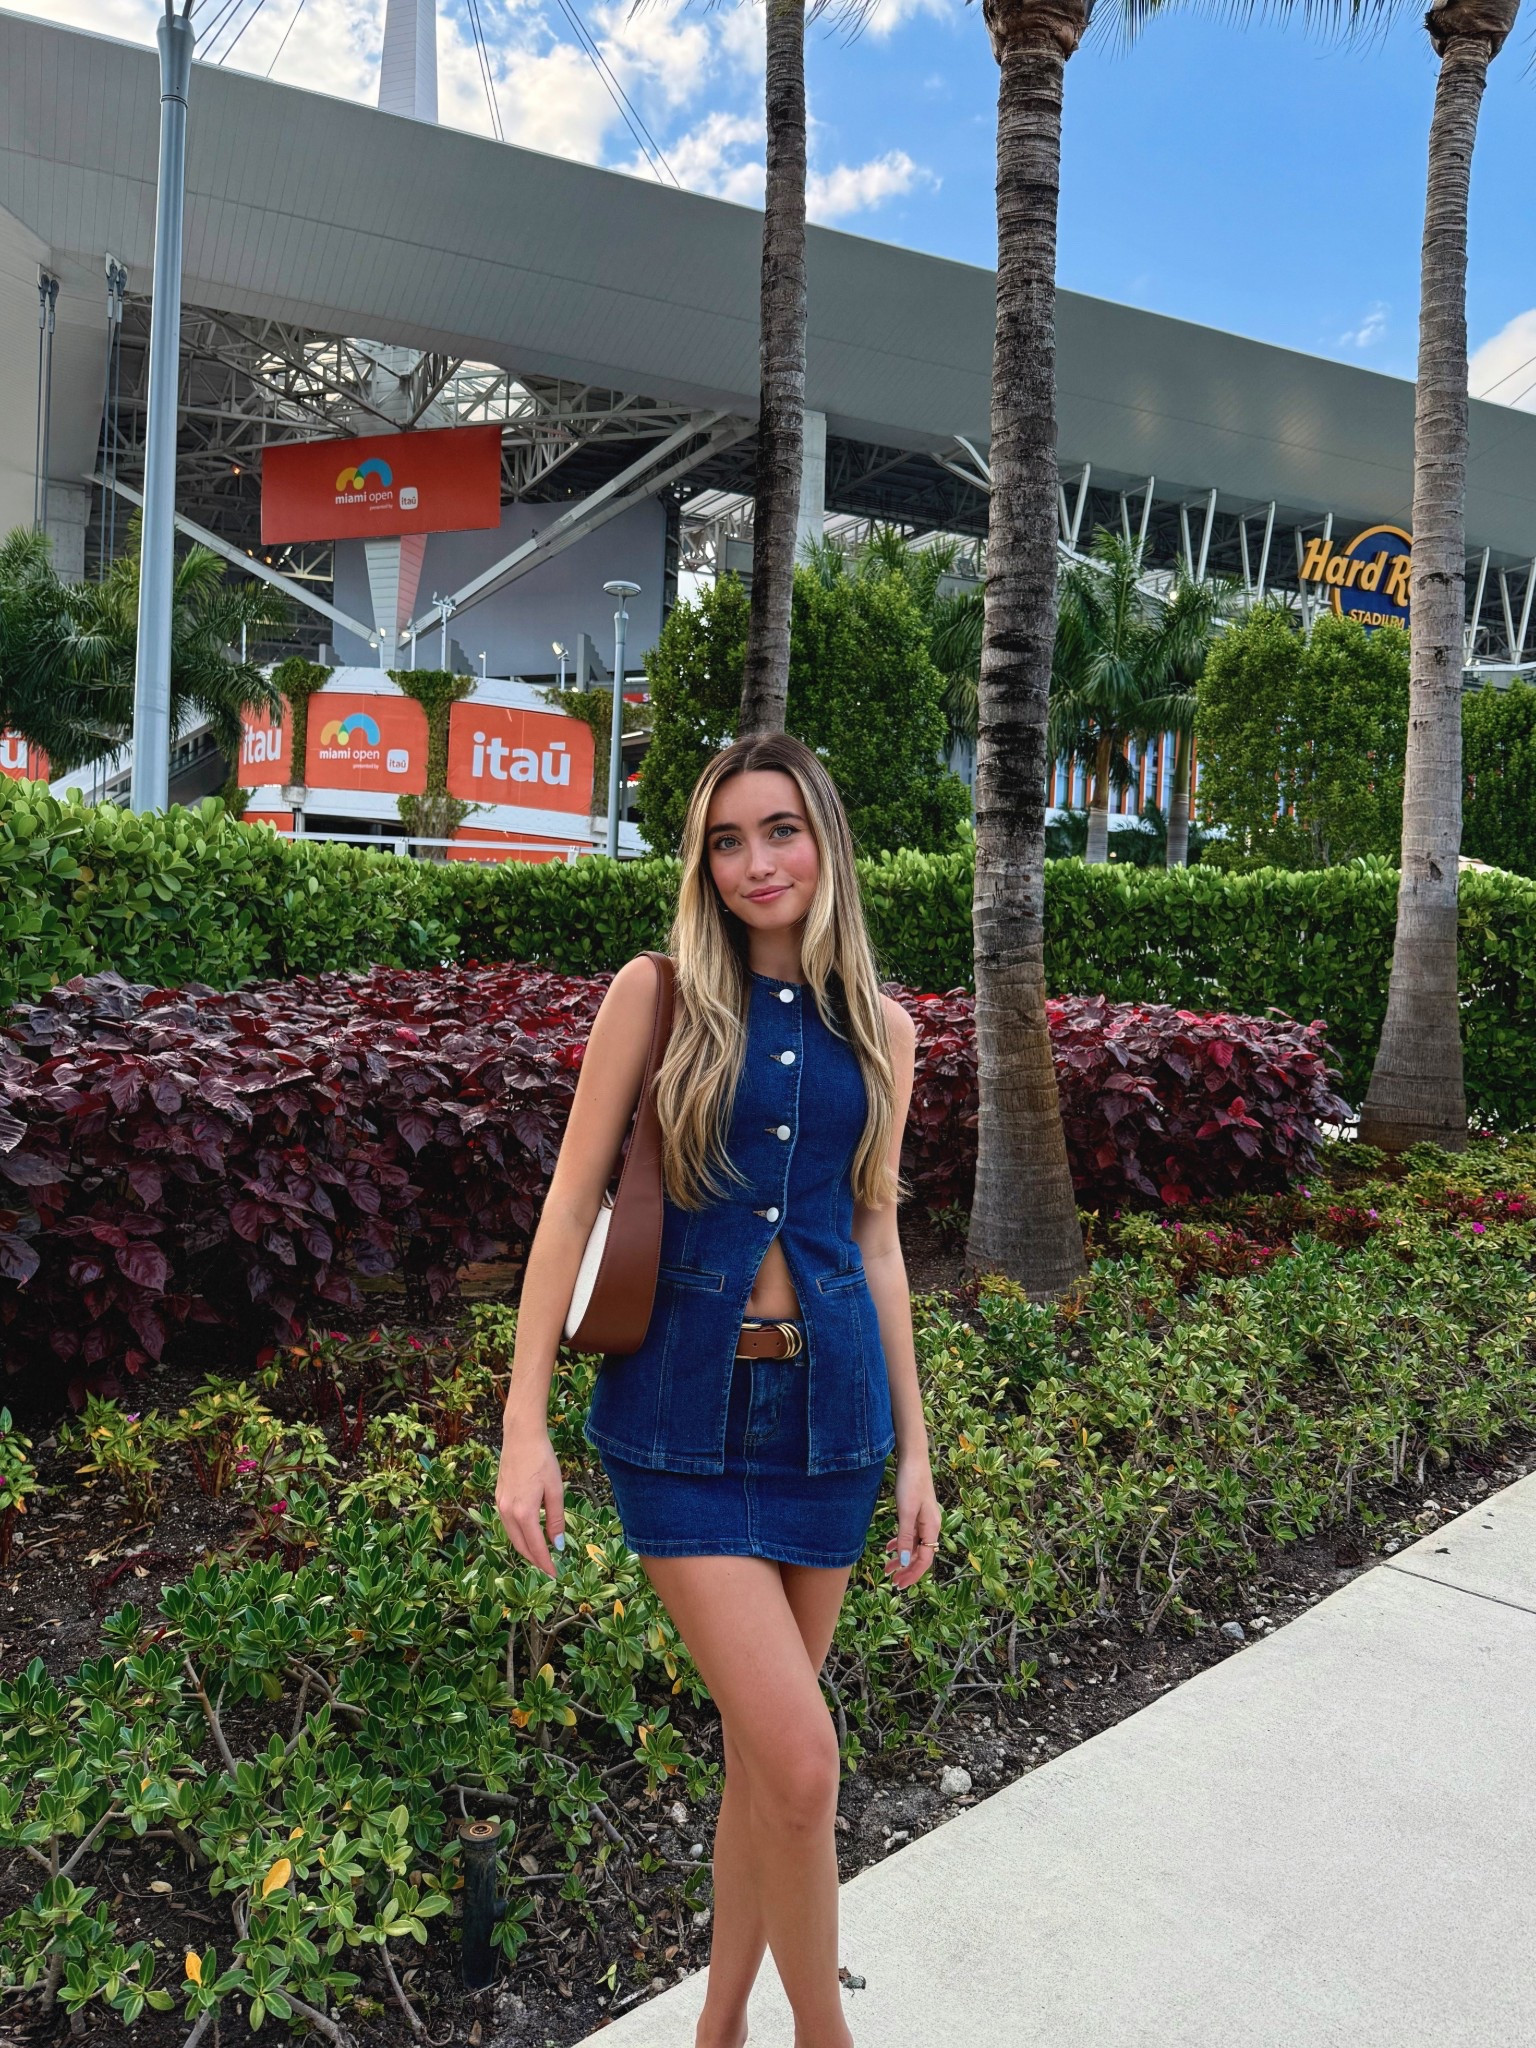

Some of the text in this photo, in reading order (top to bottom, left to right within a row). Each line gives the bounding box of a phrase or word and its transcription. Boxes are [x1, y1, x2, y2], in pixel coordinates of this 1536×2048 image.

[335, 491, 393, 504] miami open
[1300, 538, 1411, 607] Hard R
[1350, 609, 1405, 629] STADIUM
[319, 747, 380, 762] miami open
[472, 731, 571, 786] itaú
